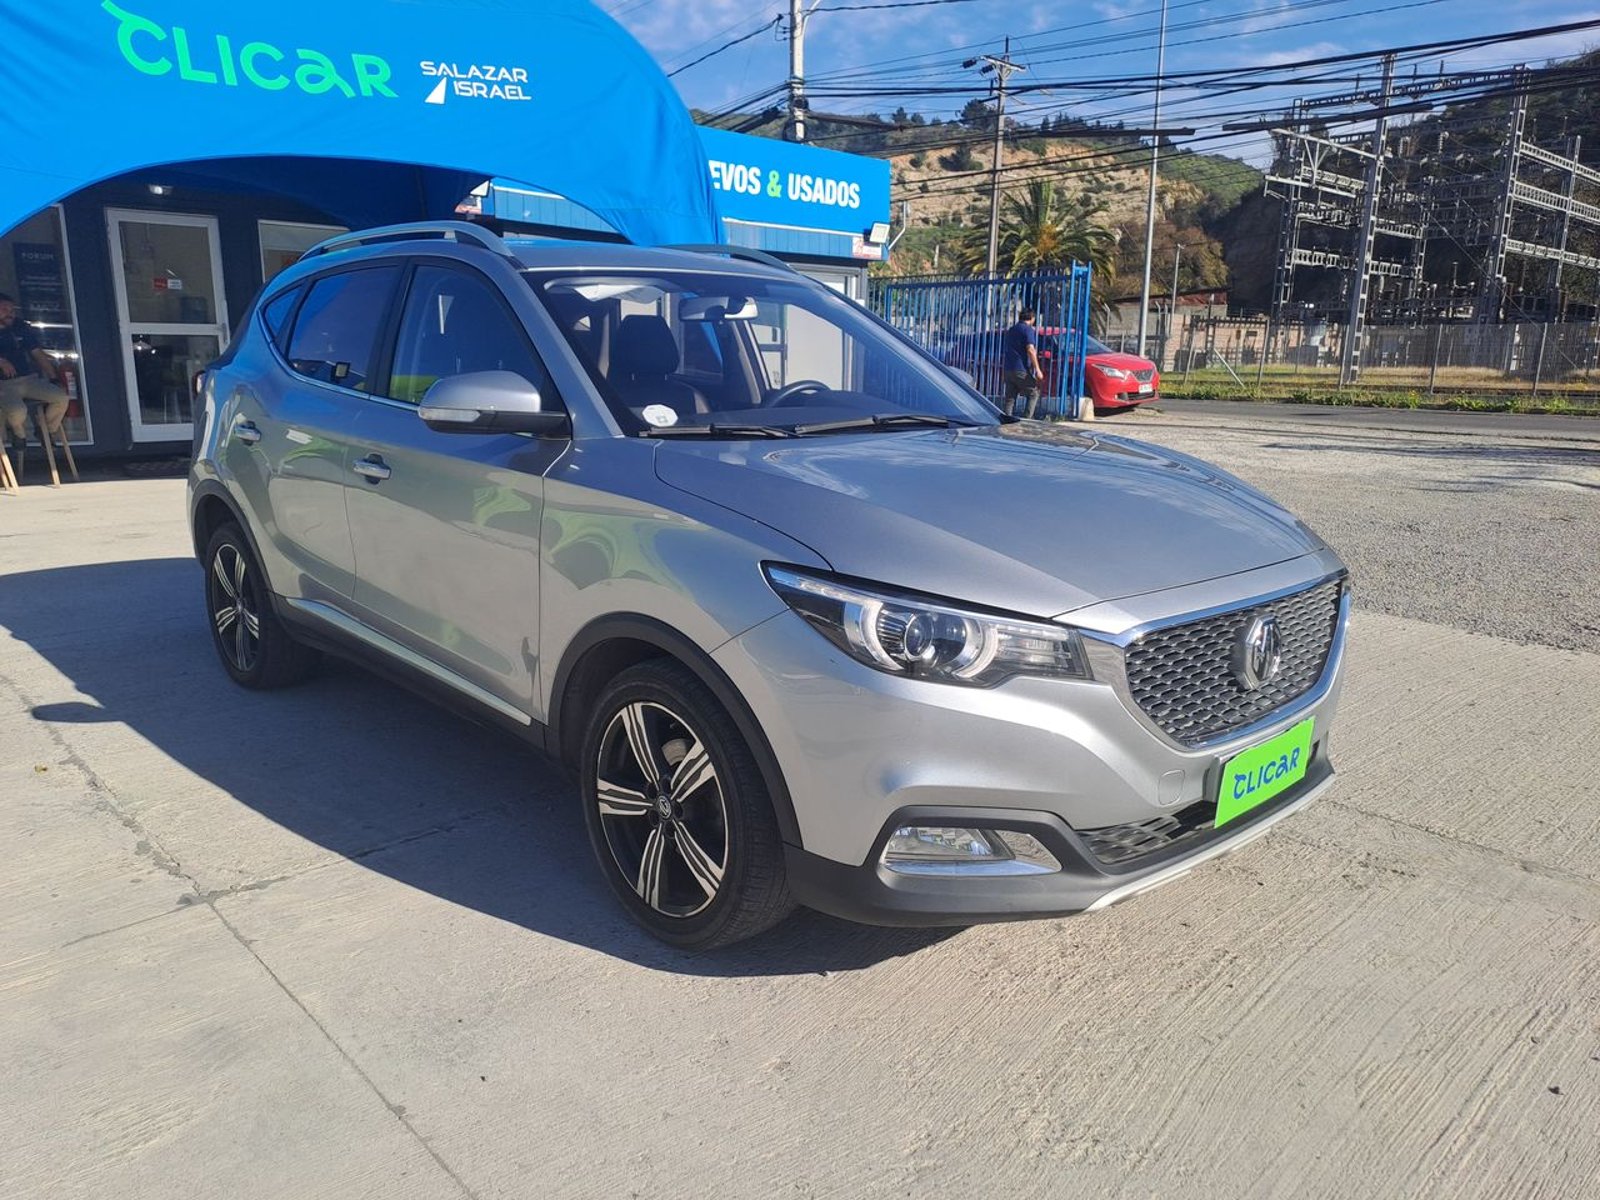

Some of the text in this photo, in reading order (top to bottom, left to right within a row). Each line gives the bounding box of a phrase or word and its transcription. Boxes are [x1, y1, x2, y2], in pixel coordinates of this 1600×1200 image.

[420, 61, 528, 84] SALAZAR
[453, 81, 531, 100] ISRAEL
[767, 170, 781, 198] &
[788, 173, 860, 209] USADOS
